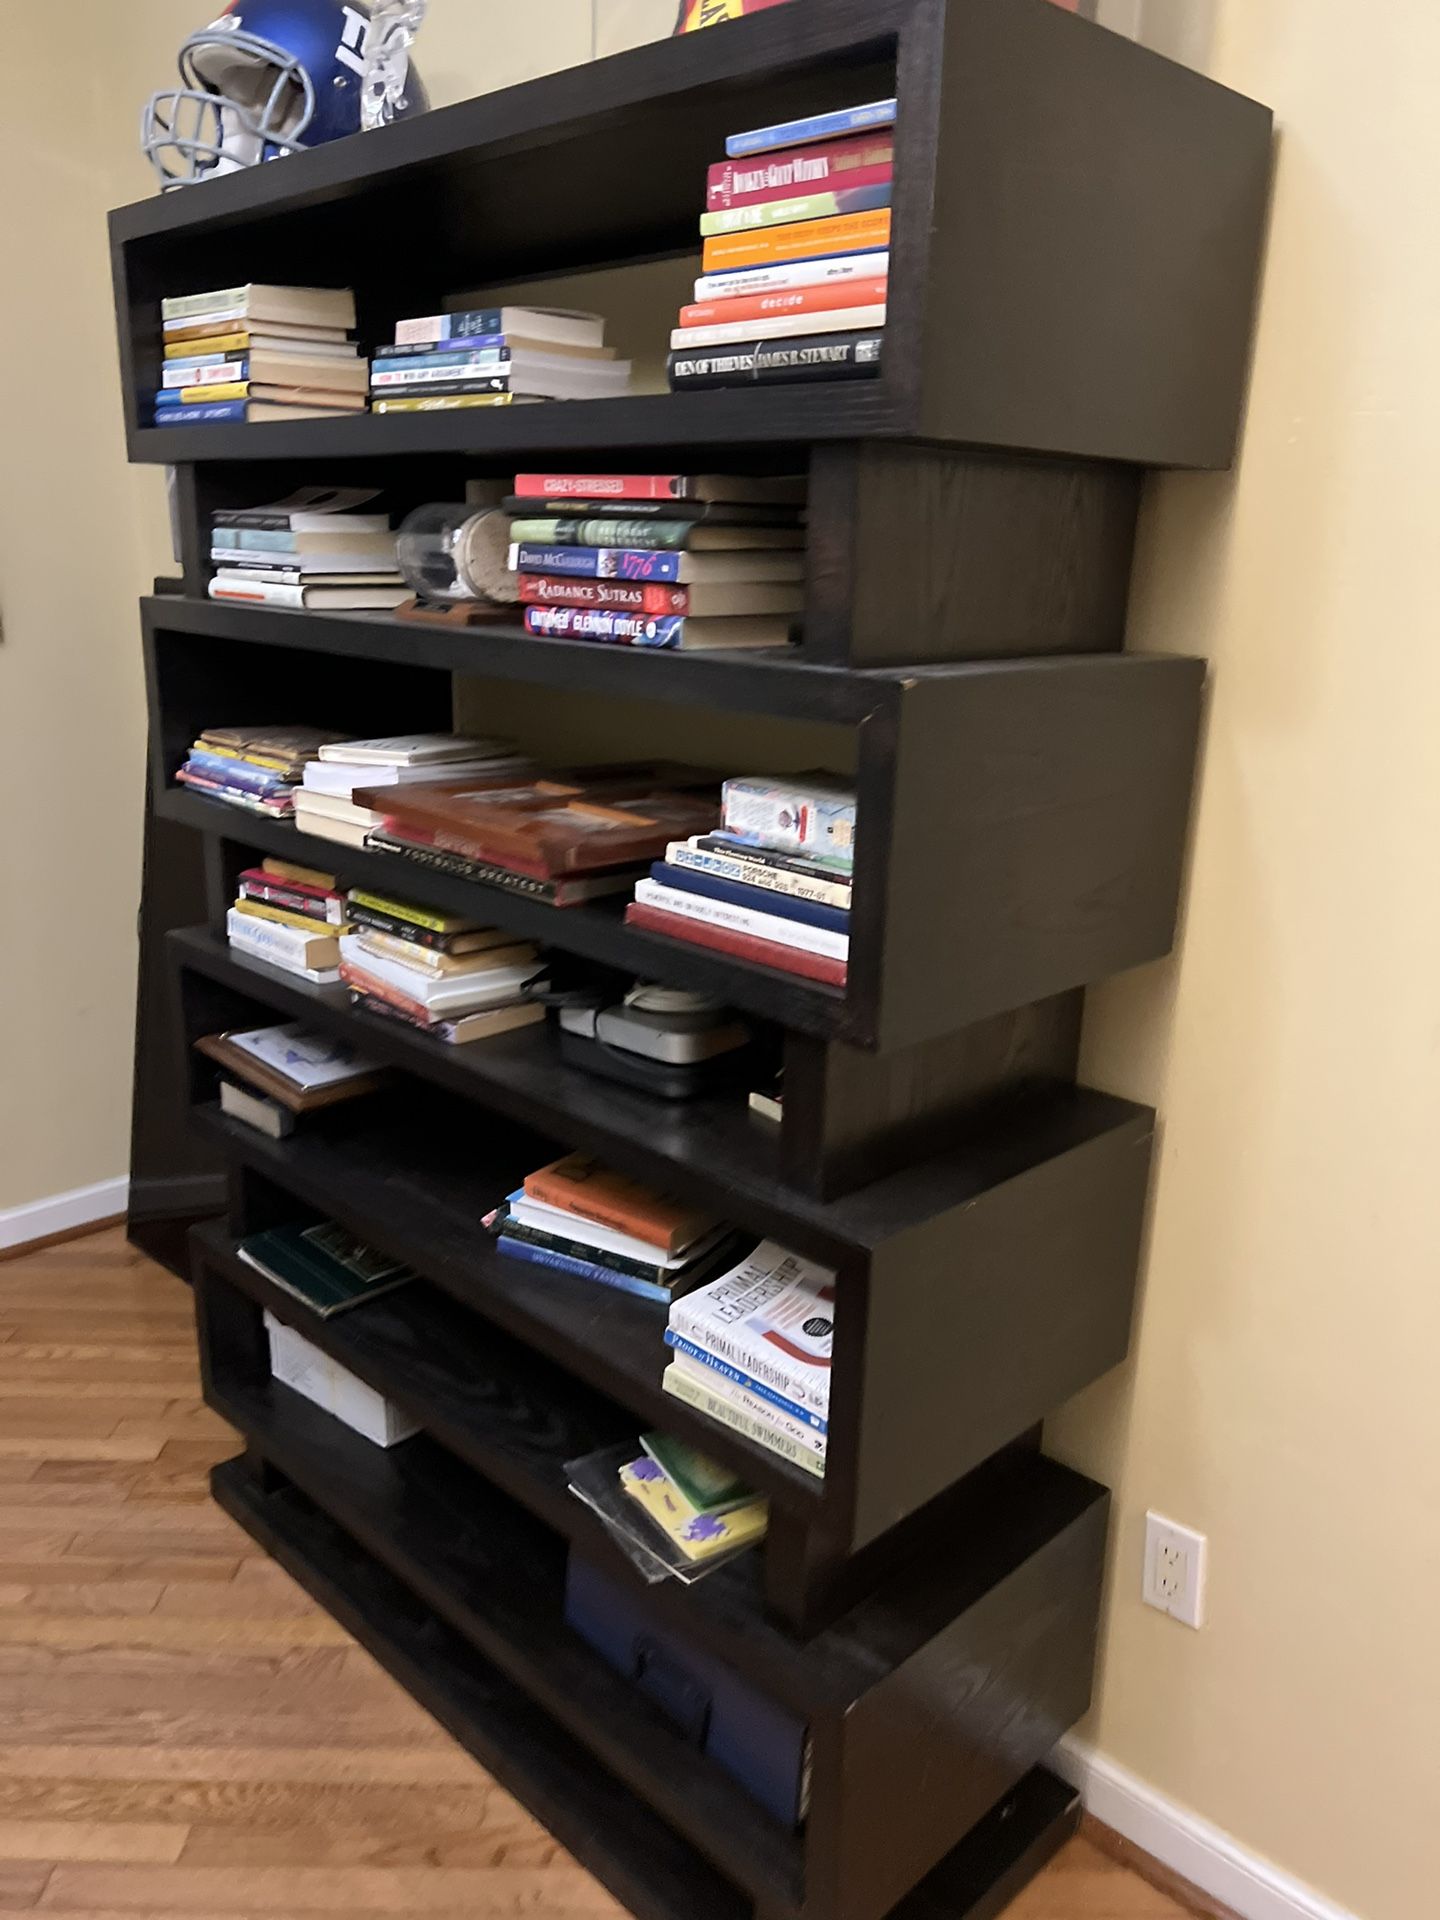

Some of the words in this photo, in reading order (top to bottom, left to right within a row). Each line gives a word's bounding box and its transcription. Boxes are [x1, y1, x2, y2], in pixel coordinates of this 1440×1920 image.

[761, 294, 803, 310] decide
[709, 355, 754, 372] THIEVES
[799, 345, 851, 364] STEWART
[544, 479, 624, 494] CRAZY-STRESSED
[622, 553, 657, 580] 1776
[538, 580, 594, 600] RADIANCE
[597, 584, 643, 603] SUTRAS
[531, 610, 569, 630] UNTAMED
[573, 615, 613, 633] GLENNON
[614, 619, 644, 636] DOYLE
[477, 868, 544, 894] GREATEST
[742, 865, 778, 880] PORSCHE
[707, 1264, 772, 1304] PRIMAL
[711, 1257, 802, 1325] LEADERSHIP
[671, 1334, 698, 1358] PROOF
[706, 1354, 741, 1383] HEAVEN
[704, 1331, 735, 1361] PRIMAL
[736, 1346, 791, 1391] LEADERSHIP
[708, 1397, 750, 1431] BEAUTIFUL
[751, 1420, 798, 1459] SWIMMERS
[742, 1395, 775, 1422] REASON
[785, 1421, 805, 1440] GOD
